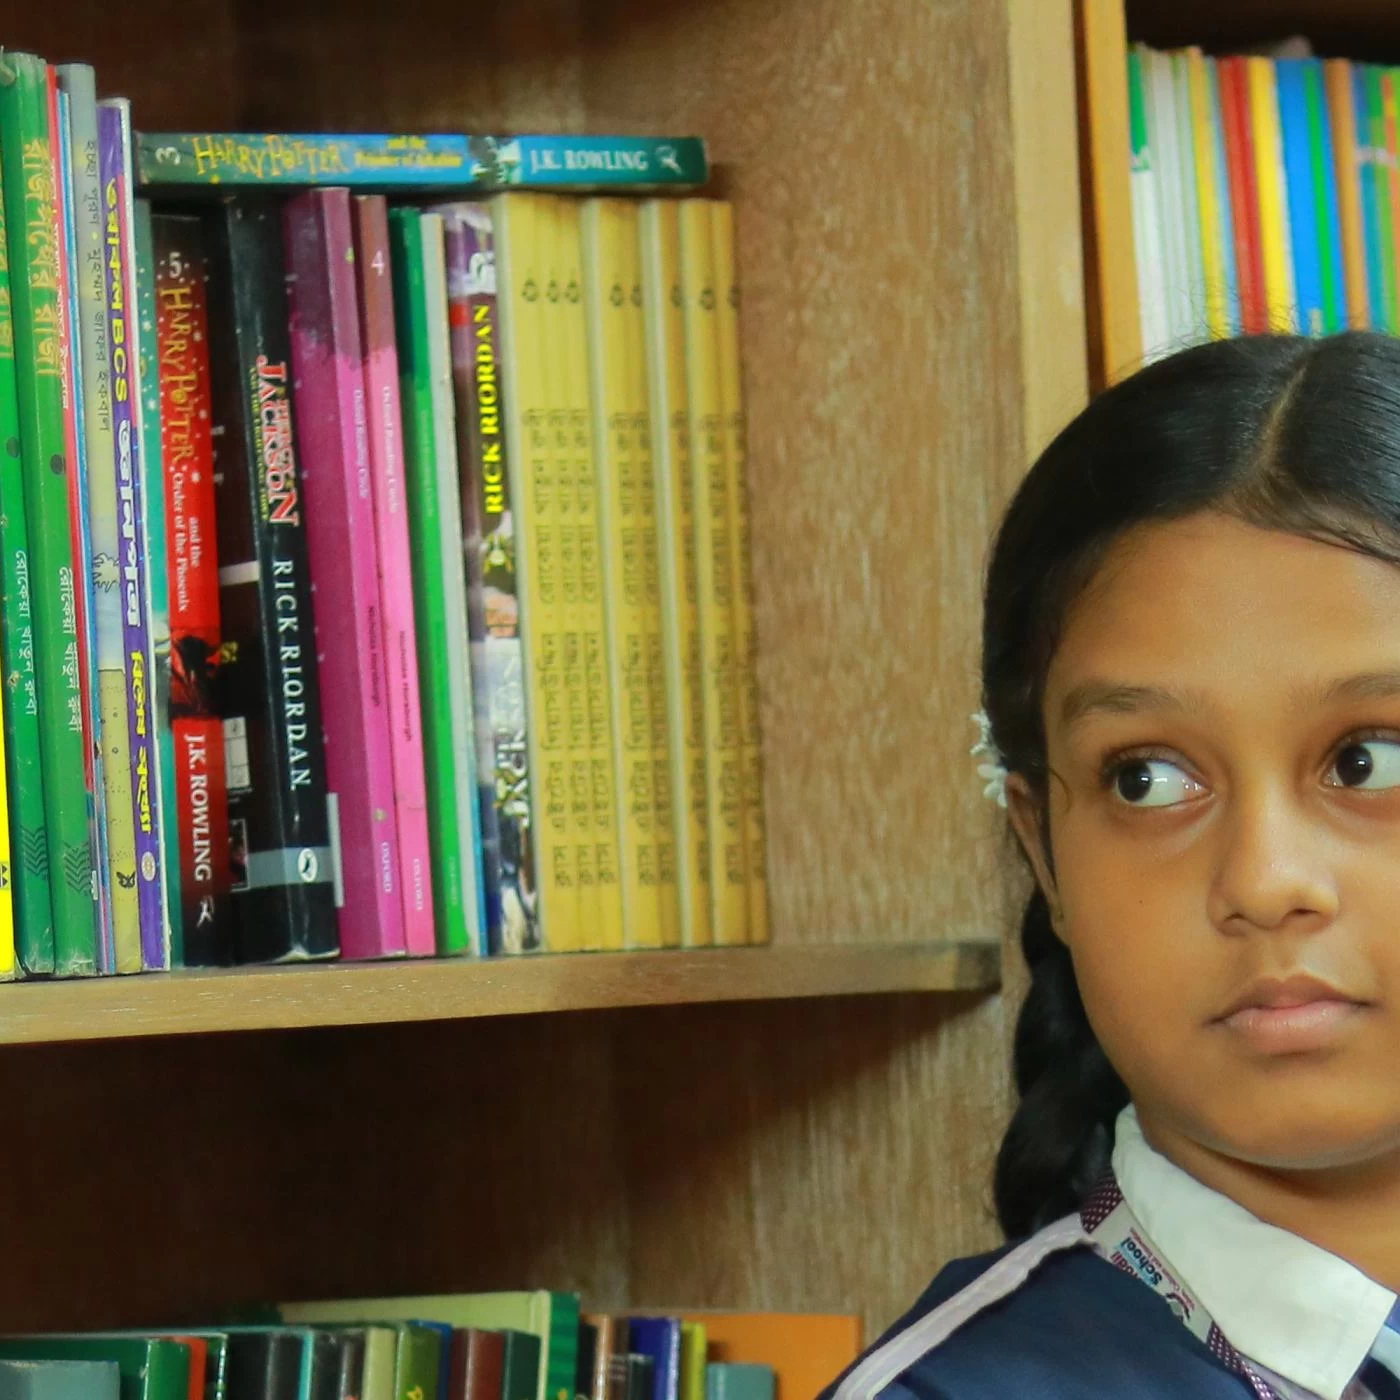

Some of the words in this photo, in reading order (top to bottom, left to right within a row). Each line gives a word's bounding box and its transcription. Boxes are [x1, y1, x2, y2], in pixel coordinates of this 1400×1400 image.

[563, 149, 649, 171] ROWLING
[168, 252, 189, 278] 5
[112, 318, 129, 402] BCS
[159, 286, 194, 371] HARRY
[473, 304, 500, 435] RIORDAN
[162, 372, 199, 462] POTTER
[253, 355, 298, 526] JACKSON
[480, 441, 505, 514] RICK
[177, 557, 193, 613] Phoenix
[272, 561, 300, 634] RICK
[183, 735, 205, 770] J.K.
[189, 775, 212, 881] ROWLING
